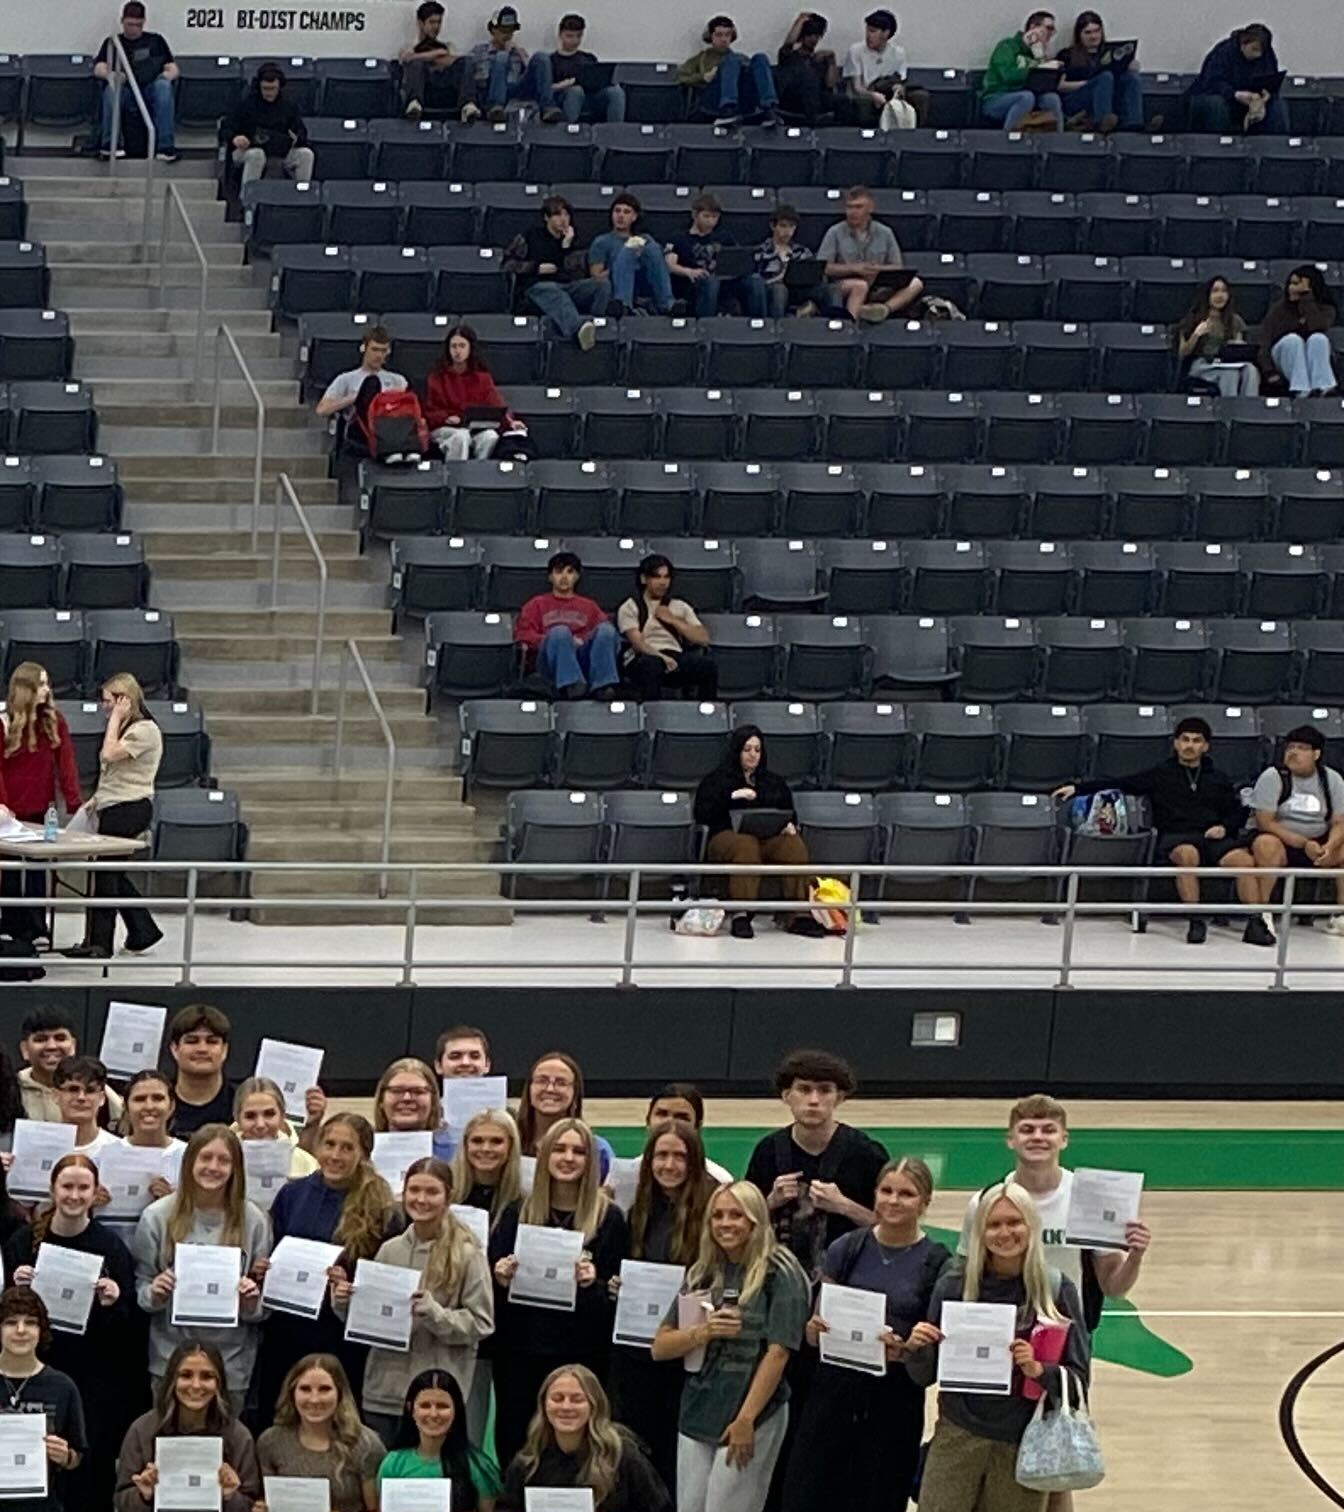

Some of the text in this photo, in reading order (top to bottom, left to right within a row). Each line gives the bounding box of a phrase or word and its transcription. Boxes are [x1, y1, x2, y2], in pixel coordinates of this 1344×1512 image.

[186, 8, 366, 31] 2021 BI-DIST CHAMPS
